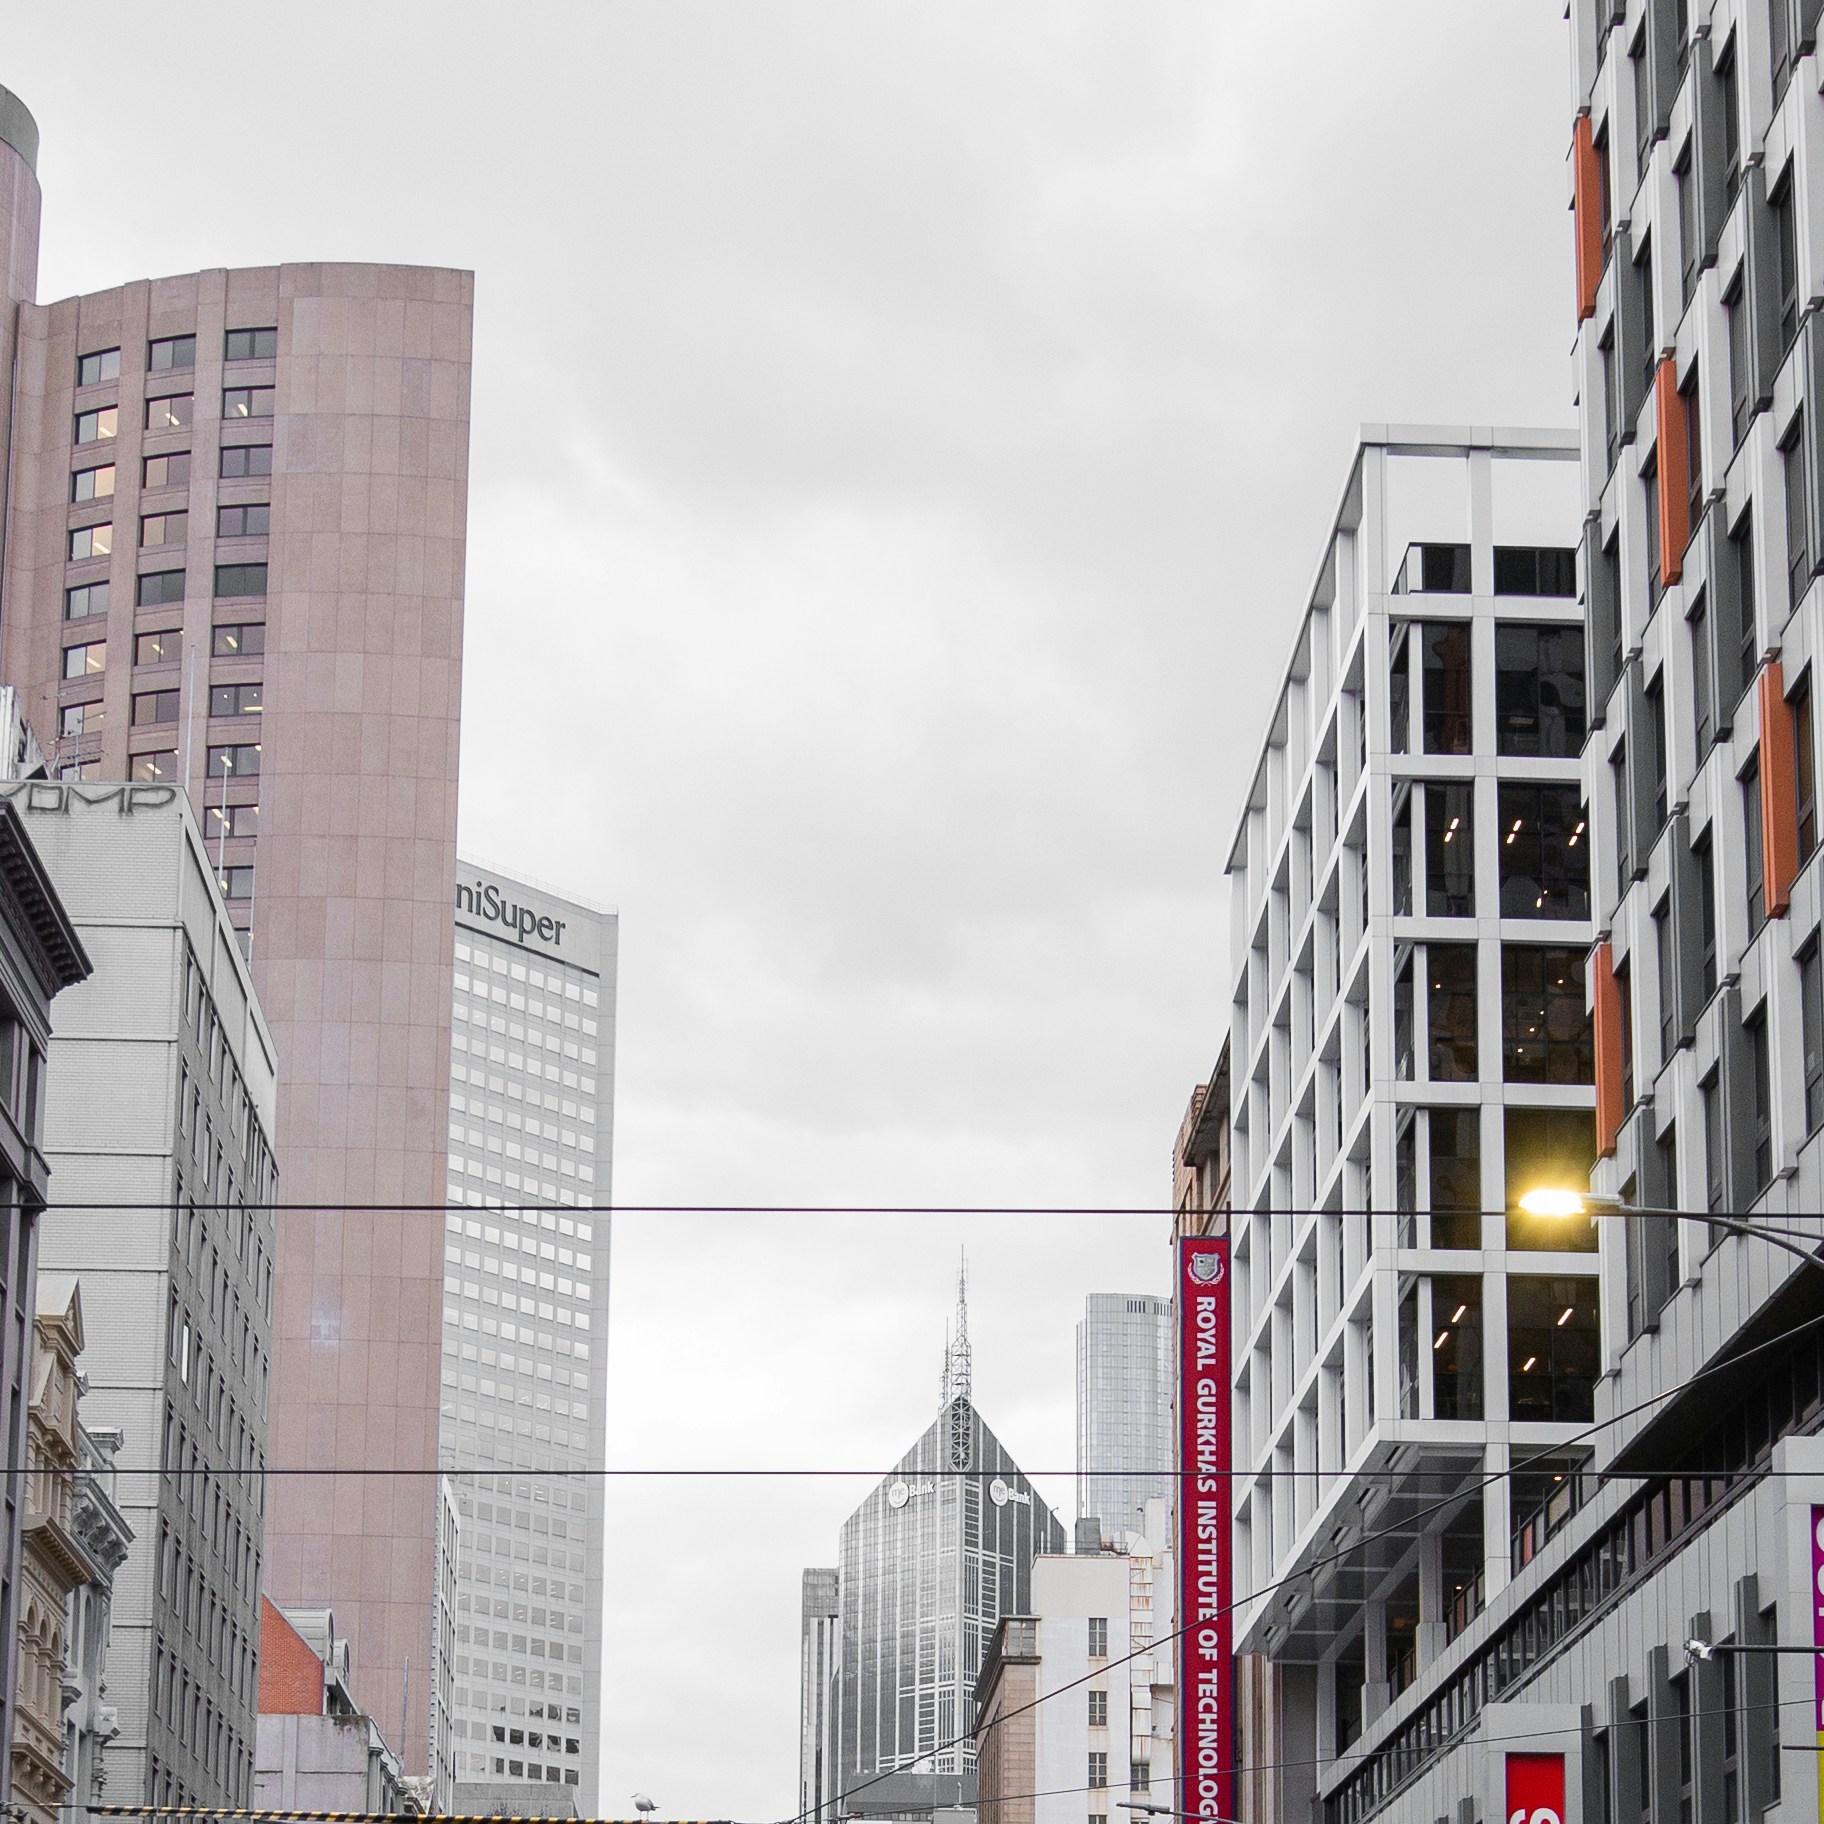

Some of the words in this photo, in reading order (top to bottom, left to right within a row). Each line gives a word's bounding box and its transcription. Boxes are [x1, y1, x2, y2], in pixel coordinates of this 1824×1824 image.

[456, 881, 566, 946] niSuper
[1196, 1296, 1217, 1371] ROYAL
[1196, 1377, 1218, 1493] GURKHAS
[1196, 1499, 1218, 1623] INSTITUTE
[1197, 1628, 1219, 1662] OF
